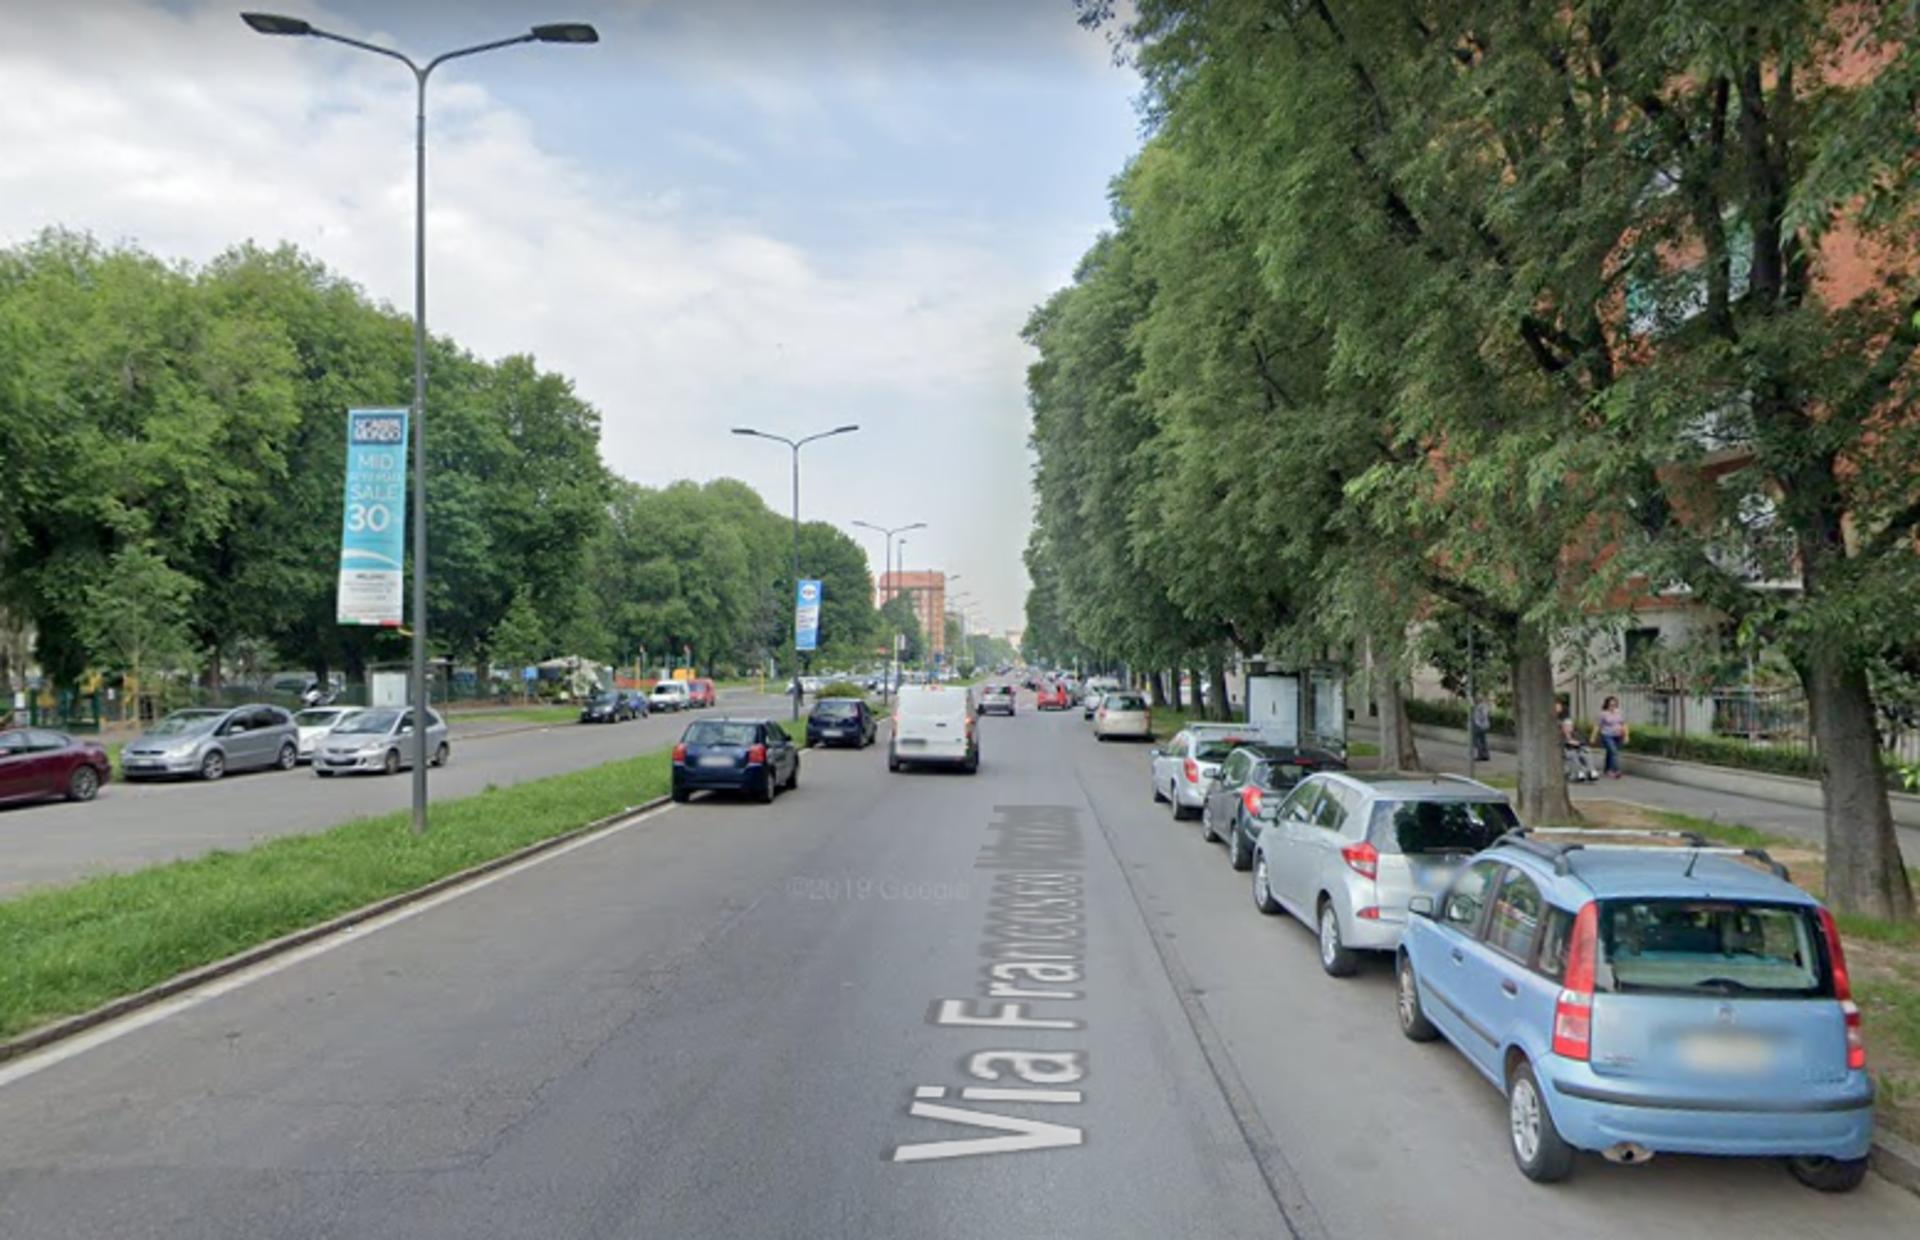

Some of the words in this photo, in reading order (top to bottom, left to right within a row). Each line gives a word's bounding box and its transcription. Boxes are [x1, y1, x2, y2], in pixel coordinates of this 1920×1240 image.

[357, 453, 394, 470] MID
[350, 484, 400, 500] SALE
[347, 503, 390, 532] 30
